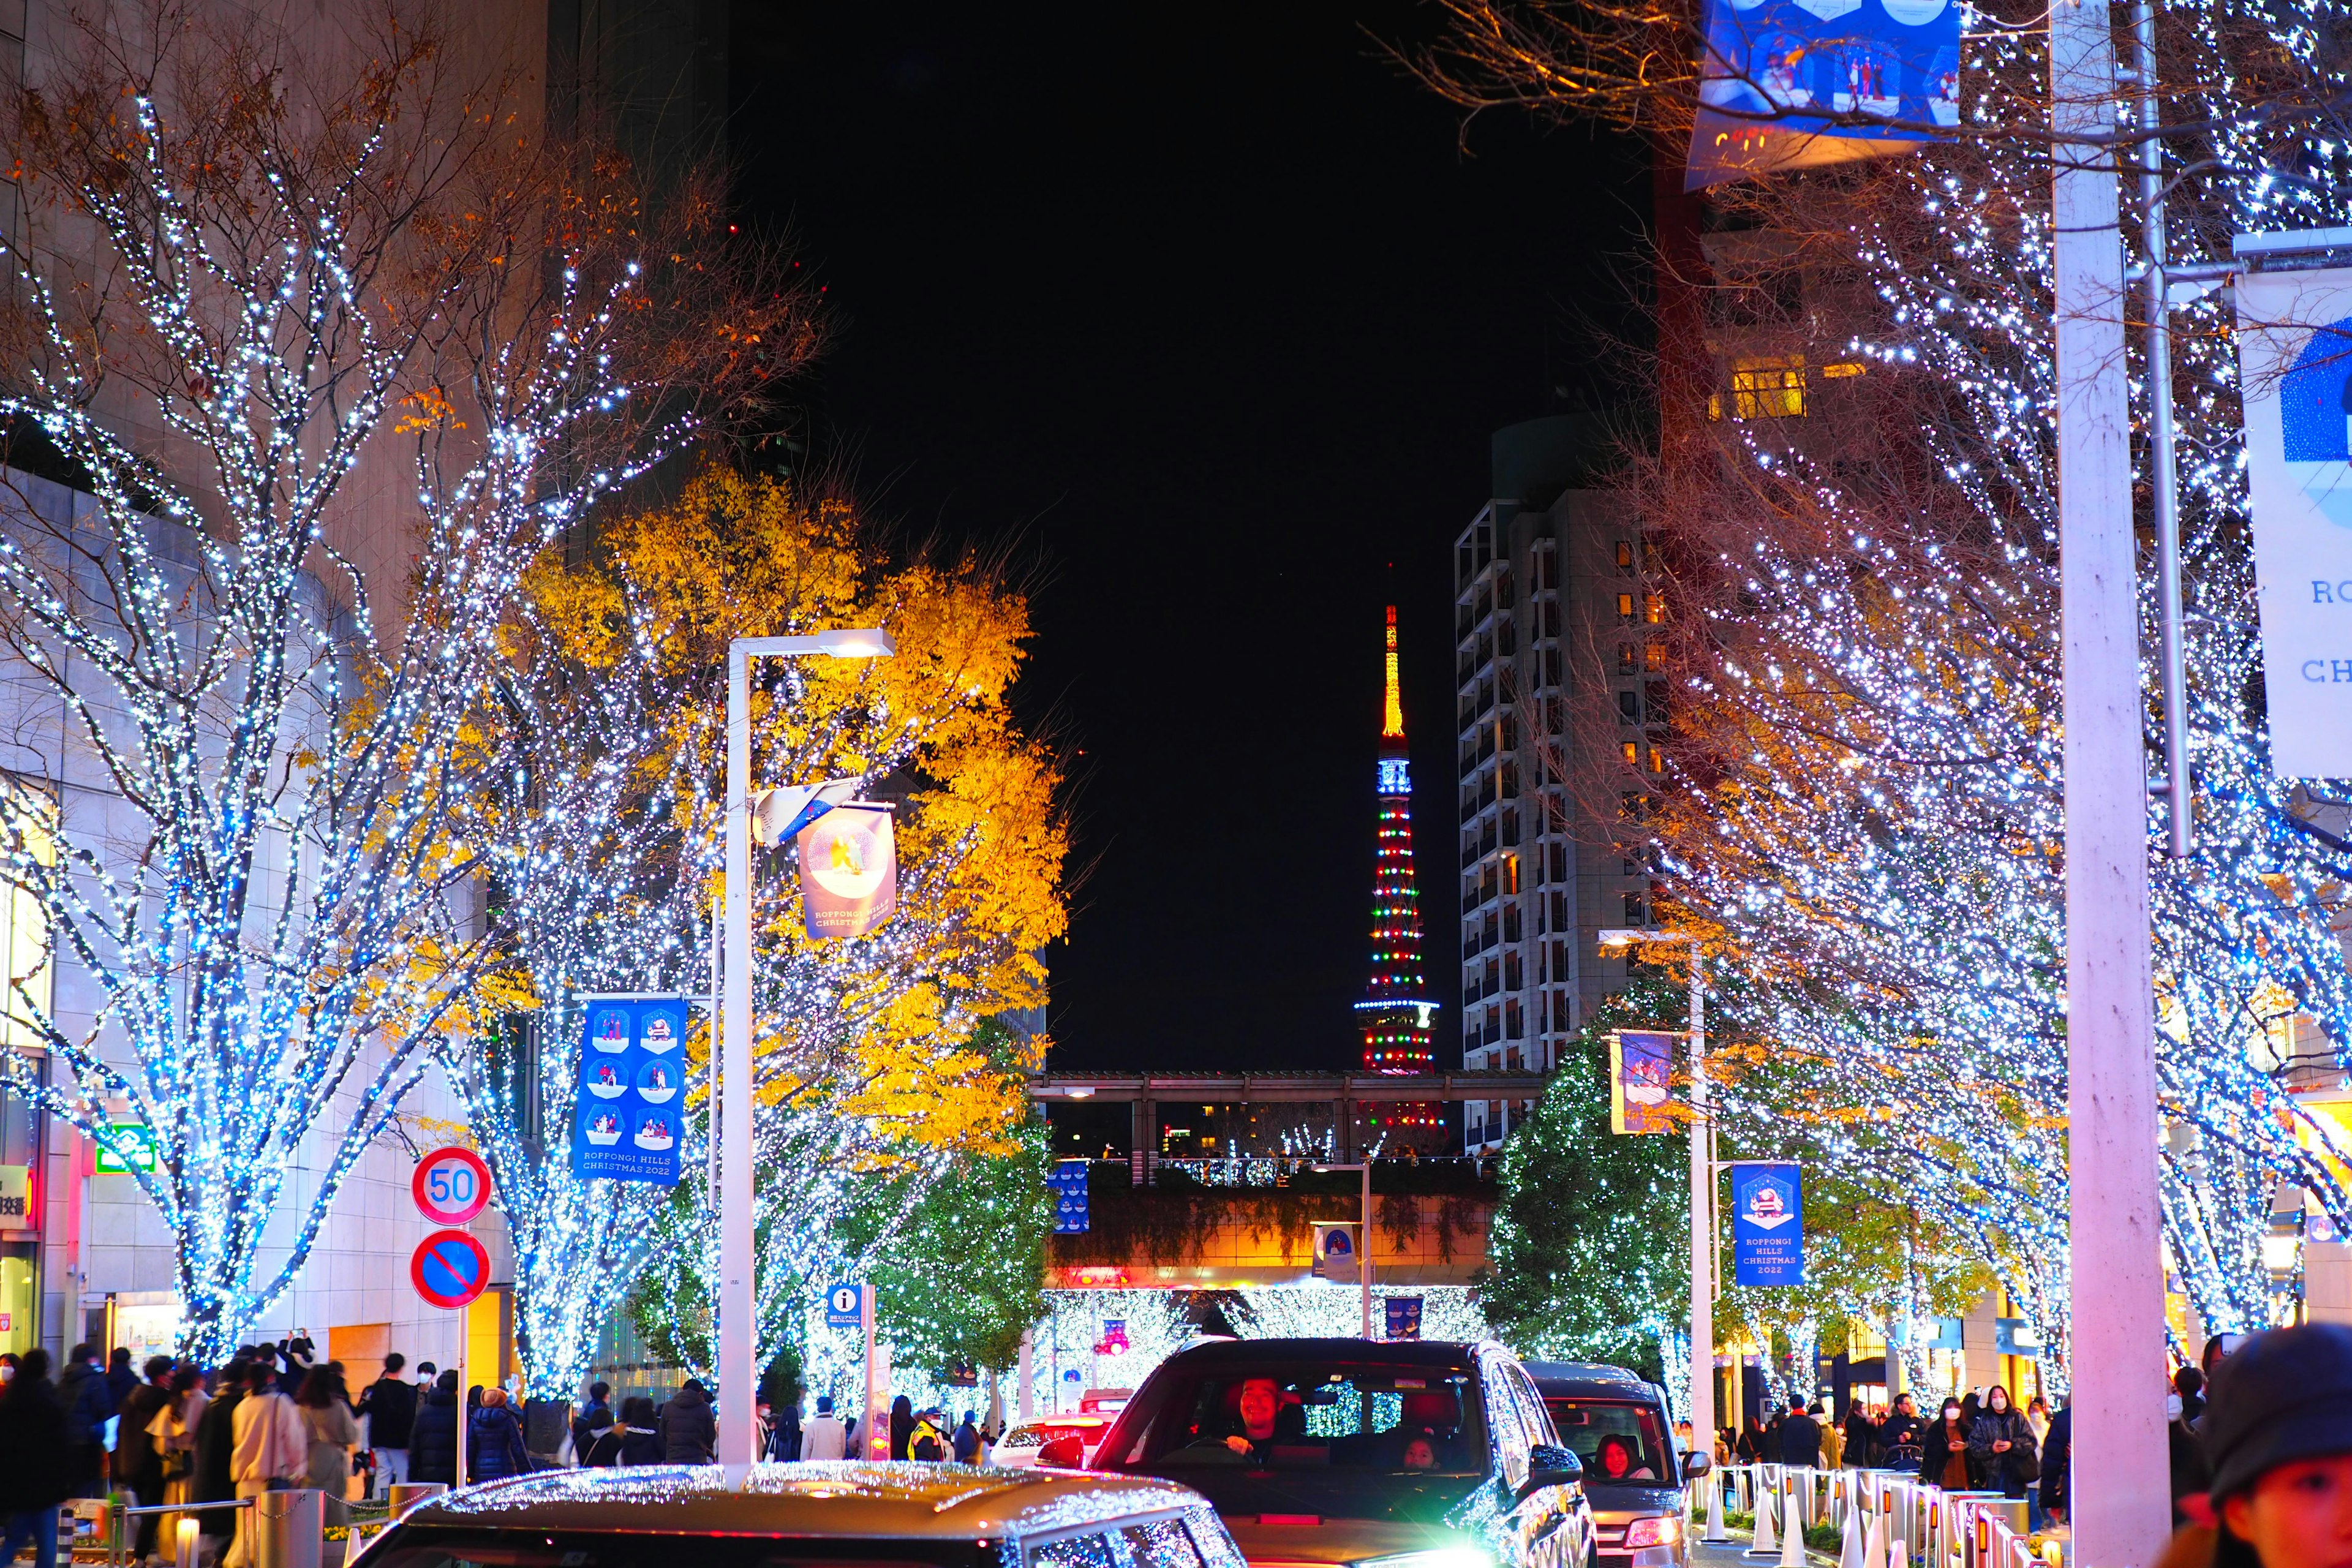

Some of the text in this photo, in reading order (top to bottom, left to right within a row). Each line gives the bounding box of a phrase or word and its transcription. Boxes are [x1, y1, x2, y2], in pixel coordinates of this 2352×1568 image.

[2301, 660, 2352, 683] CH
[816, 917, 870, 927] CHRISTMAS
[584, 1152, 671, 1165] ROPPONGI HILLS
[582, 1162, 669, 1175] CHRISTMAS 2022
[431, 1169, 472, 1202] 50
[0, 1196, 25, 1216] 交番
